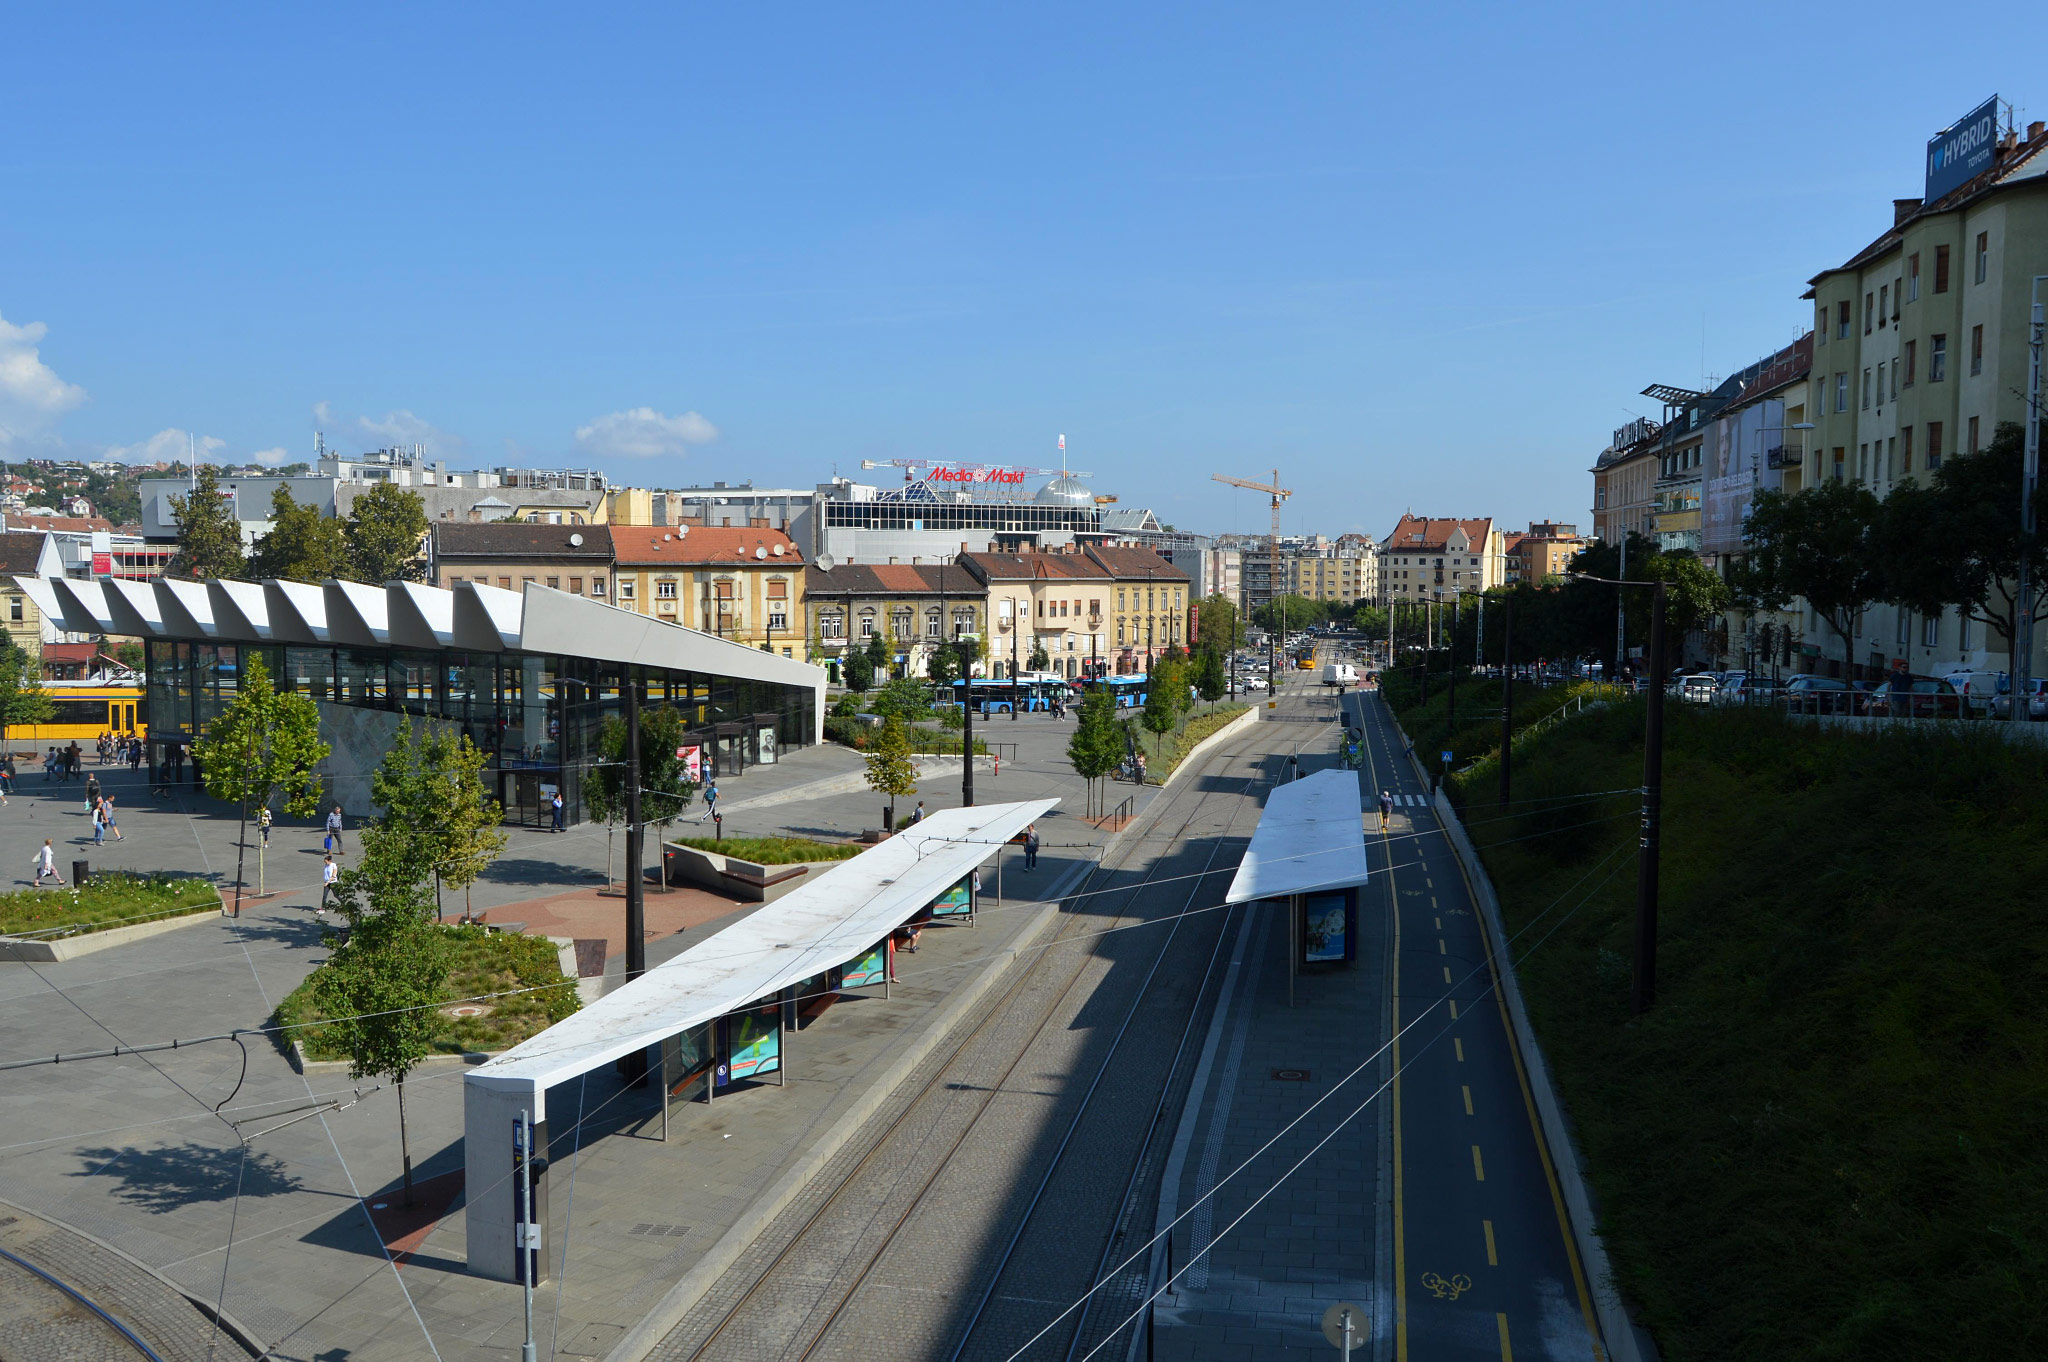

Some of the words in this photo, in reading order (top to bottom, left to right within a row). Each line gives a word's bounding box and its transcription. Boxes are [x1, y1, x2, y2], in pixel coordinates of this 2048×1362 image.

[1943, 116, 1991, 167] HYBRID
[1967, 148, 1990, 168] TOYOTA
[927, 467, 974, 482] Media
[984, 468, 1025, 483] Markt
